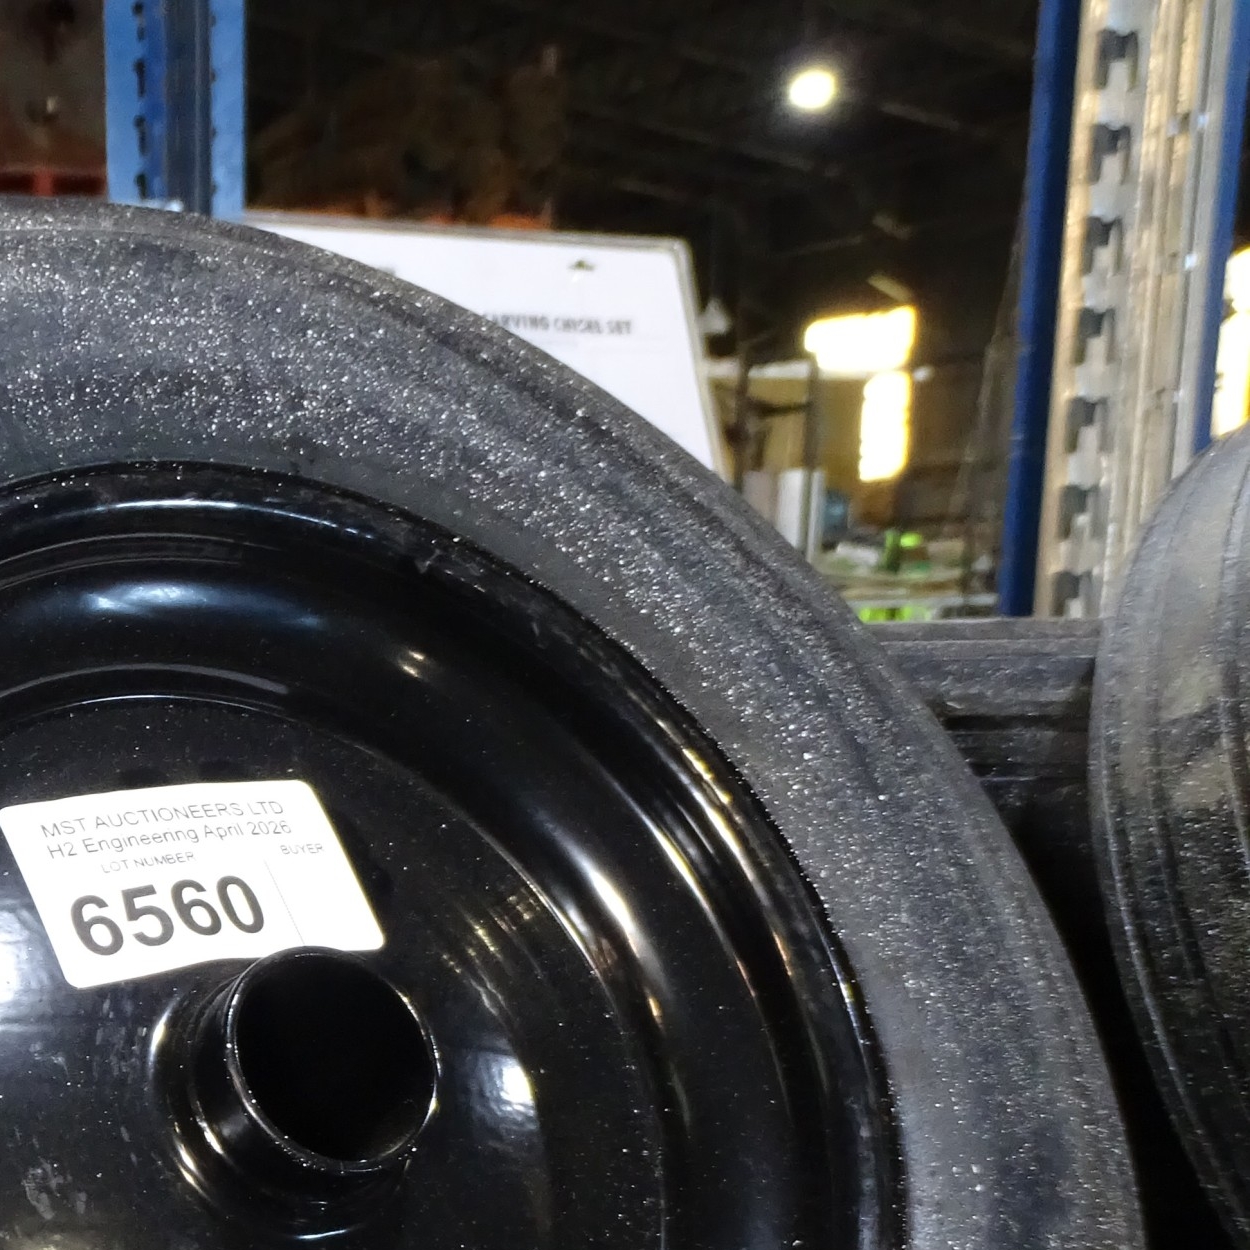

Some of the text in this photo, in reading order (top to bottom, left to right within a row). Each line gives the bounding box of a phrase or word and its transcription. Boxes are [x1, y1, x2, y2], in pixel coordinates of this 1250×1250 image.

[40, 801, 284, 838] MST AUCTIONEERS LTD
[47, 820, 291, 859] H2 Engineering April 2026
[280, 843, 325, 855] BUYER
[101, 851, 196, 874] LOT NUMBER
[70, 875, 265, 956] 6560
